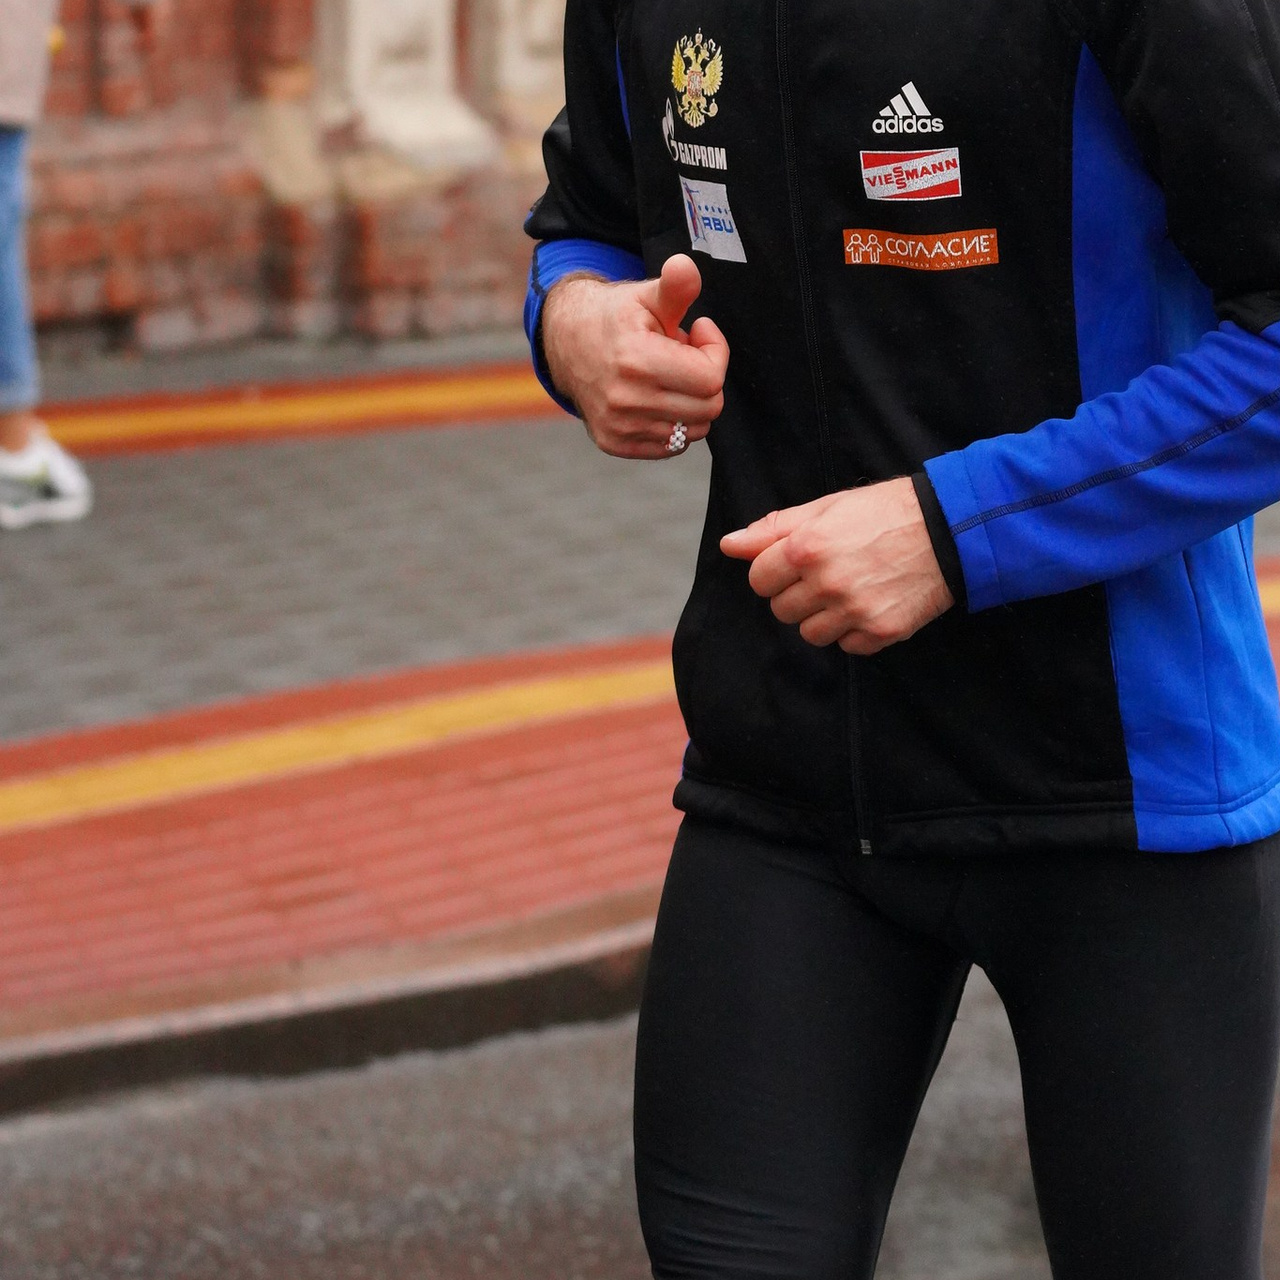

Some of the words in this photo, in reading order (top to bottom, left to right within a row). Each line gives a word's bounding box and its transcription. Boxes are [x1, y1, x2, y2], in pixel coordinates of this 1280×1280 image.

[872, 115, 944, 133] adidas
[678, 141, 727, 170] GAZPROM
[865, 158, 958, 189] VIESSMANN
[885, 234, 990, 258] СОГЛАСИЕ
